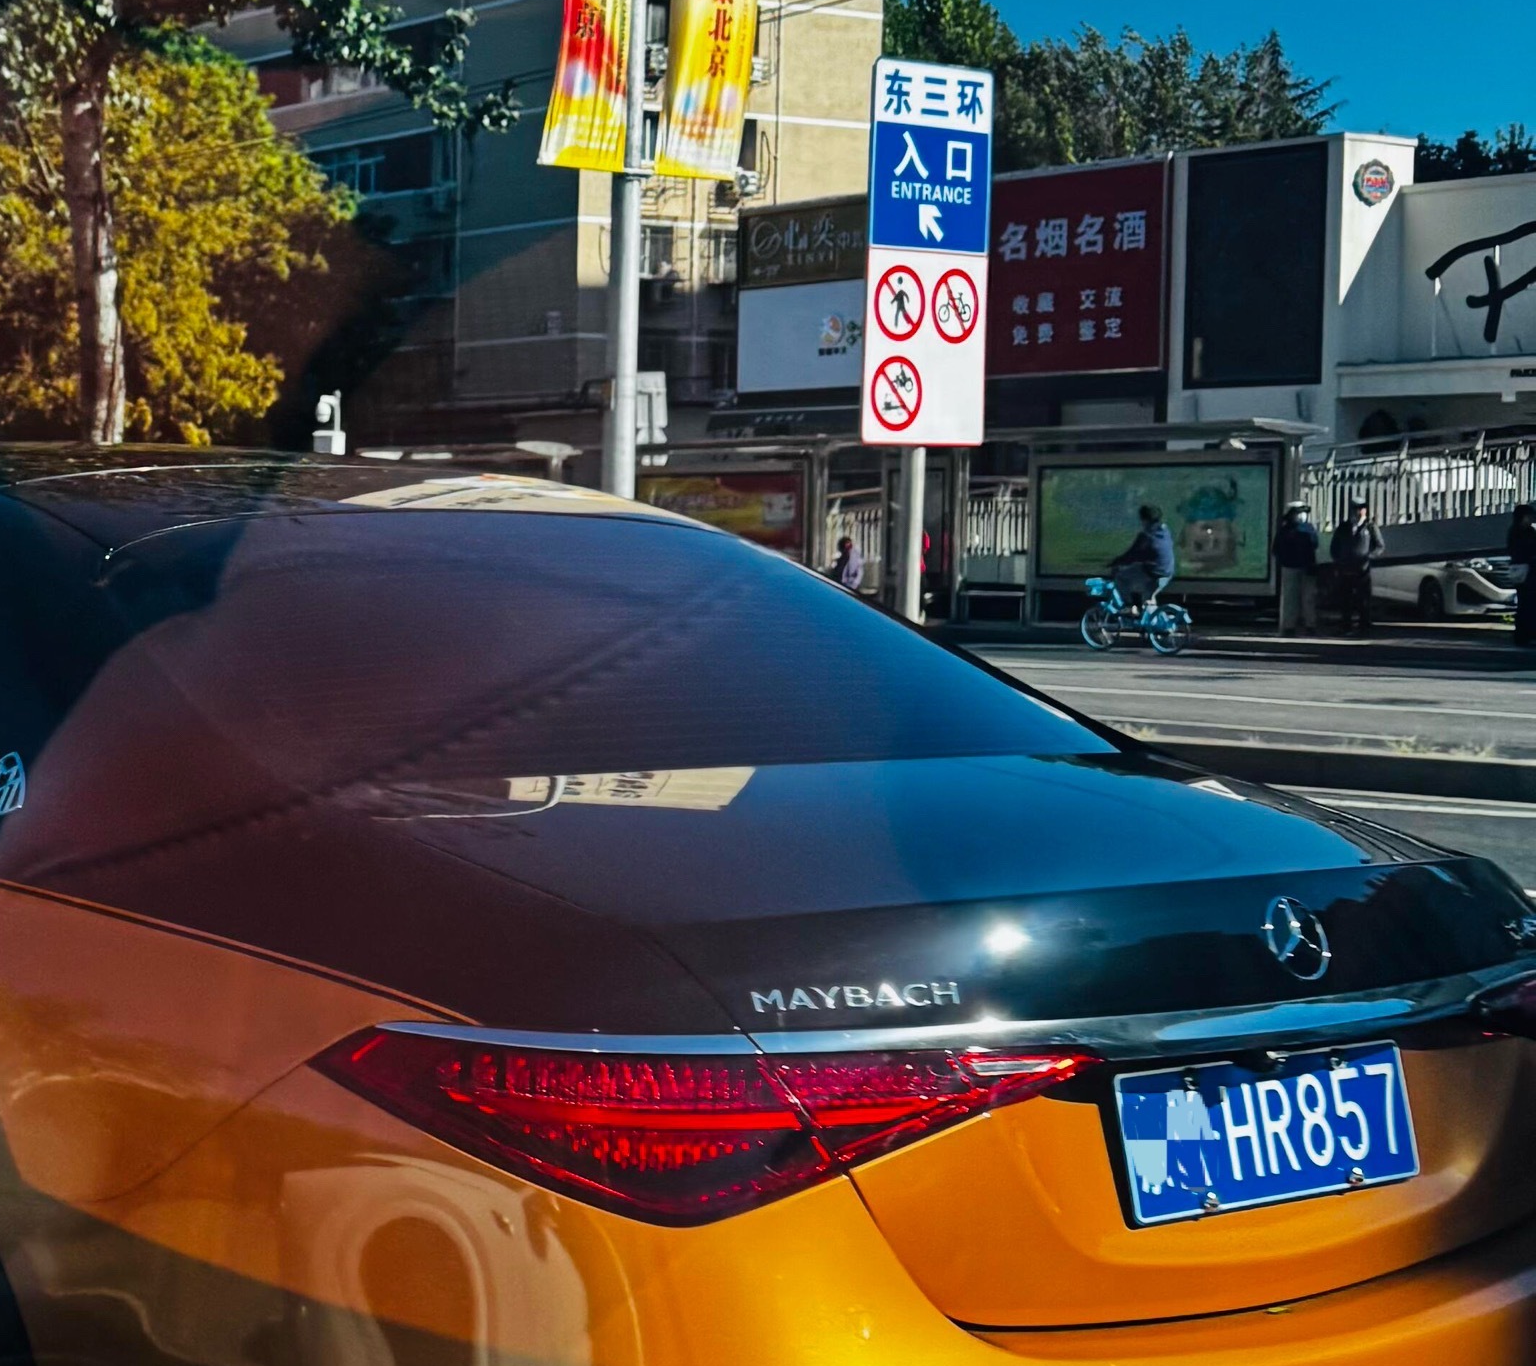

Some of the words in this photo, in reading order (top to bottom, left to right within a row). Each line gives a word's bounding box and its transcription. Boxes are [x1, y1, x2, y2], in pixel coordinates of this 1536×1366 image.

[883, 68, 985, 125] 东三环
[893, 130, 973, 183] 入口
[891, 180, 972, 205] ENTRANCE
[998, 209, 1147, 262] 名烟名酒
[749, 981, 961, 1014] MAYBACH
